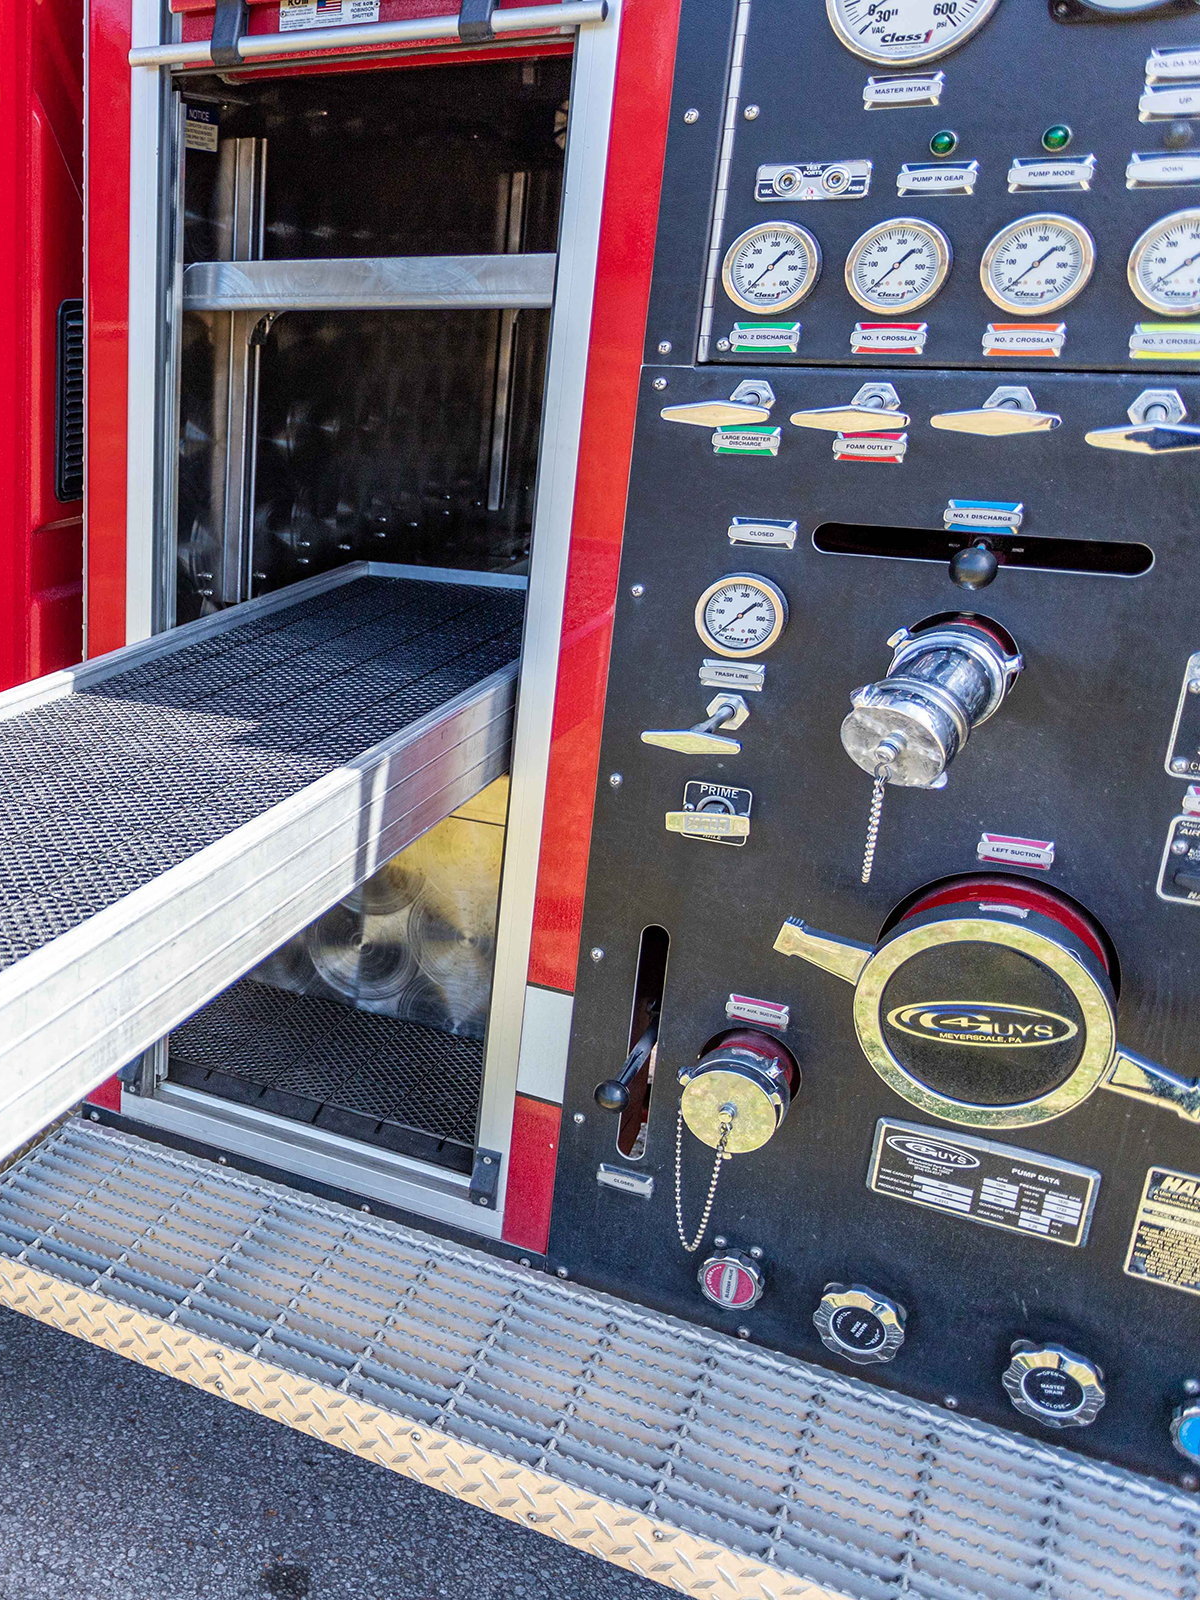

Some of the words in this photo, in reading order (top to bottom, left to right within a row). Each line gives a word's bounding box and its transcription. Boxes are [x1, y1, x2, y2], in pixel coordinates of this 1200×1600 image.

[933, 2, 957, 16] 600
[936, 20, 948, 29] psi
[871, 26, 886, 34] VAC
[874, 87, 904, 95] MASTER
[905, 85, 932, 93] INTAKE
[188, 108, 210, 122] NOTICE
[943, 174, 964, 182] GEAR
[1051, 169, 1075, 177] MODE
[700, 784, 739, 799] PRIME
[991, 846, 1009, 854] LEFT
[1010, 849, 1042, 859] SUCTION
[759, 1011, 782, 1020] SUCTION
[939, 1032, 1007, 1043] MEYERSDALE,
[892, 1170, 913, 1179] CAPACITY
[1011, 1167, 1037, 1179] PUMP
[1037, 1174, 1060, 1186] DATA
[613, 1178, 635, 1188] CLOSED
[879, 1174, 910, 1187] MANUFACTURE
[877, 1182, 905, 1193] PRODUCTION
[1019, 1182, 1046, 1193] PRESSURE
[1048, 1190, 1068, 1199] ENGINE
[979, 1202, 1004, 1212] GOVERNOR
[1004, 1207, 1020, 1216] SPEED
[977, 1209, 990, 1217] GEAR
[990, 1212, 1004, 1220] RATIO
[1040, 1383, 1065, 1391] MASTER
[1045, 1402, 1066, 1410] CLOSE
